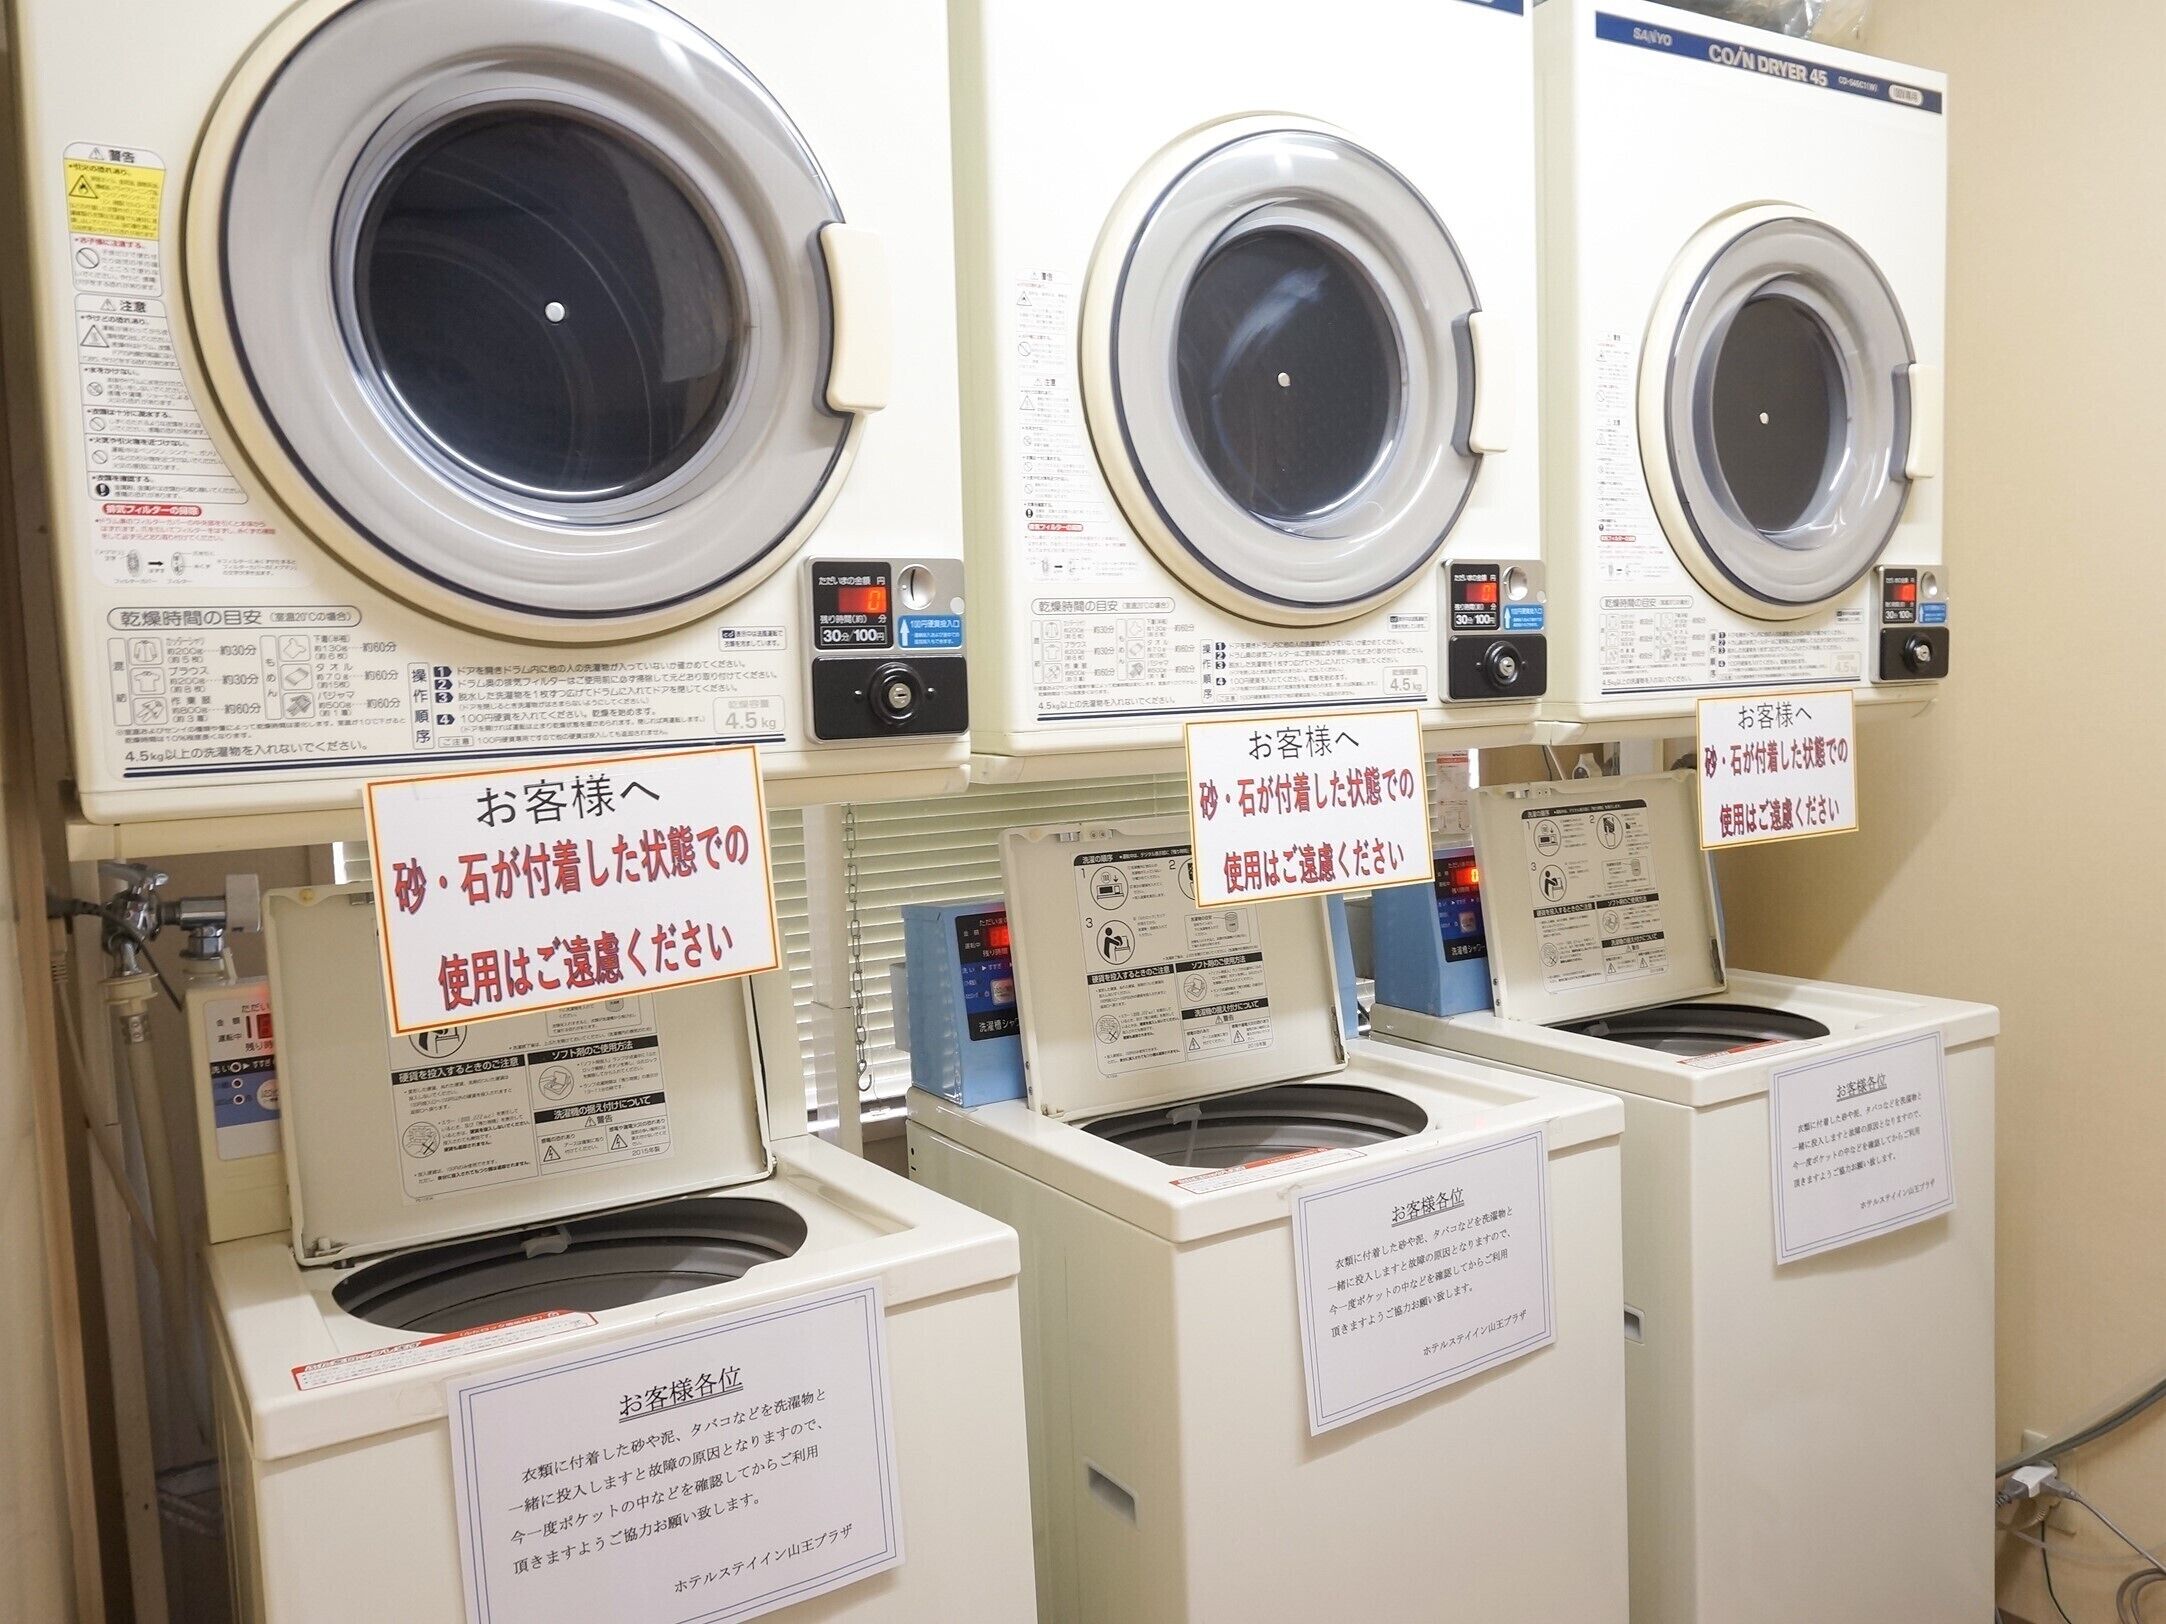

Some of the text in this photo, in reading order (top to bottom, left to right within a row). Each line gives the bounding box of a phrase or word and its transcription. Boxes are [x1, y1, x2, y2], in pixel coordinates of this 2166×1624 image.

[1633, 27, 1672, 46] SANYO
[1757, 56, 1808, 82] DRYER
[1810, 68, 1828, 86] 45
[108, 149, 135, 163] 警告
[120, 300, 146, 313] 注意
[120, 610, 262, 627] 乾燥時間の目安
[867, 590, 881, 611] 0
[822, 628, 885, 643] 30分/100円
[411, 669, 430, 744] 操作順序
[724, 712, 776, 730] 4.5 kg
[1738, 701, 1812, 730] お客様へ
[1249, 724, 1359, 760] お客様へ
[1704, 735, 1849, 779] 砂・石が付着した状態での
[476, 773, 661, 829] お客様へ
[1199, 766, 1415, 821] 砂・石が付着した状態での
[1719, 794, 1840, 838] 使用はご遠慮ください
[393, 824, 749, 915] 砂・石が付着した状態での
[1168, 859, 1176, 870] 2
[1223, 837, 1405, 894] 使用はご遠慮ください
[1085, 917, 1094, 929] 3
[437, 919, 733, 1011] 使用はご遠慮ください
[552, 1040, 634, 1060] ソフト剤のご使用方法
[398, 1056, 519, 1083] 硬貨を投入するときのご注意
[553, 1096, 651, 1120] 洗濯機の据え付けについて
[596, 1115, 613, 1124] 警告
[1391, 1187, 1465, 1223] お客様各位
[619, 1365, 743, 1420] お客様各位
[521, 1388, 826, 1484] 衣類に付着した砂や泥、タバコなどを洗濯物と
[508, 1418, 824, 1515] 一緒に投入しますと故障の原因となりますので、
[510, 1445, 820, 1546] 今一度ポケットの中などを確認してからご利用
[512, 1492, 761, 1576] 頂きますようご協力お願い致します。
[674, 1523, 853, 1594] ホテルステイイン山王プラザ
